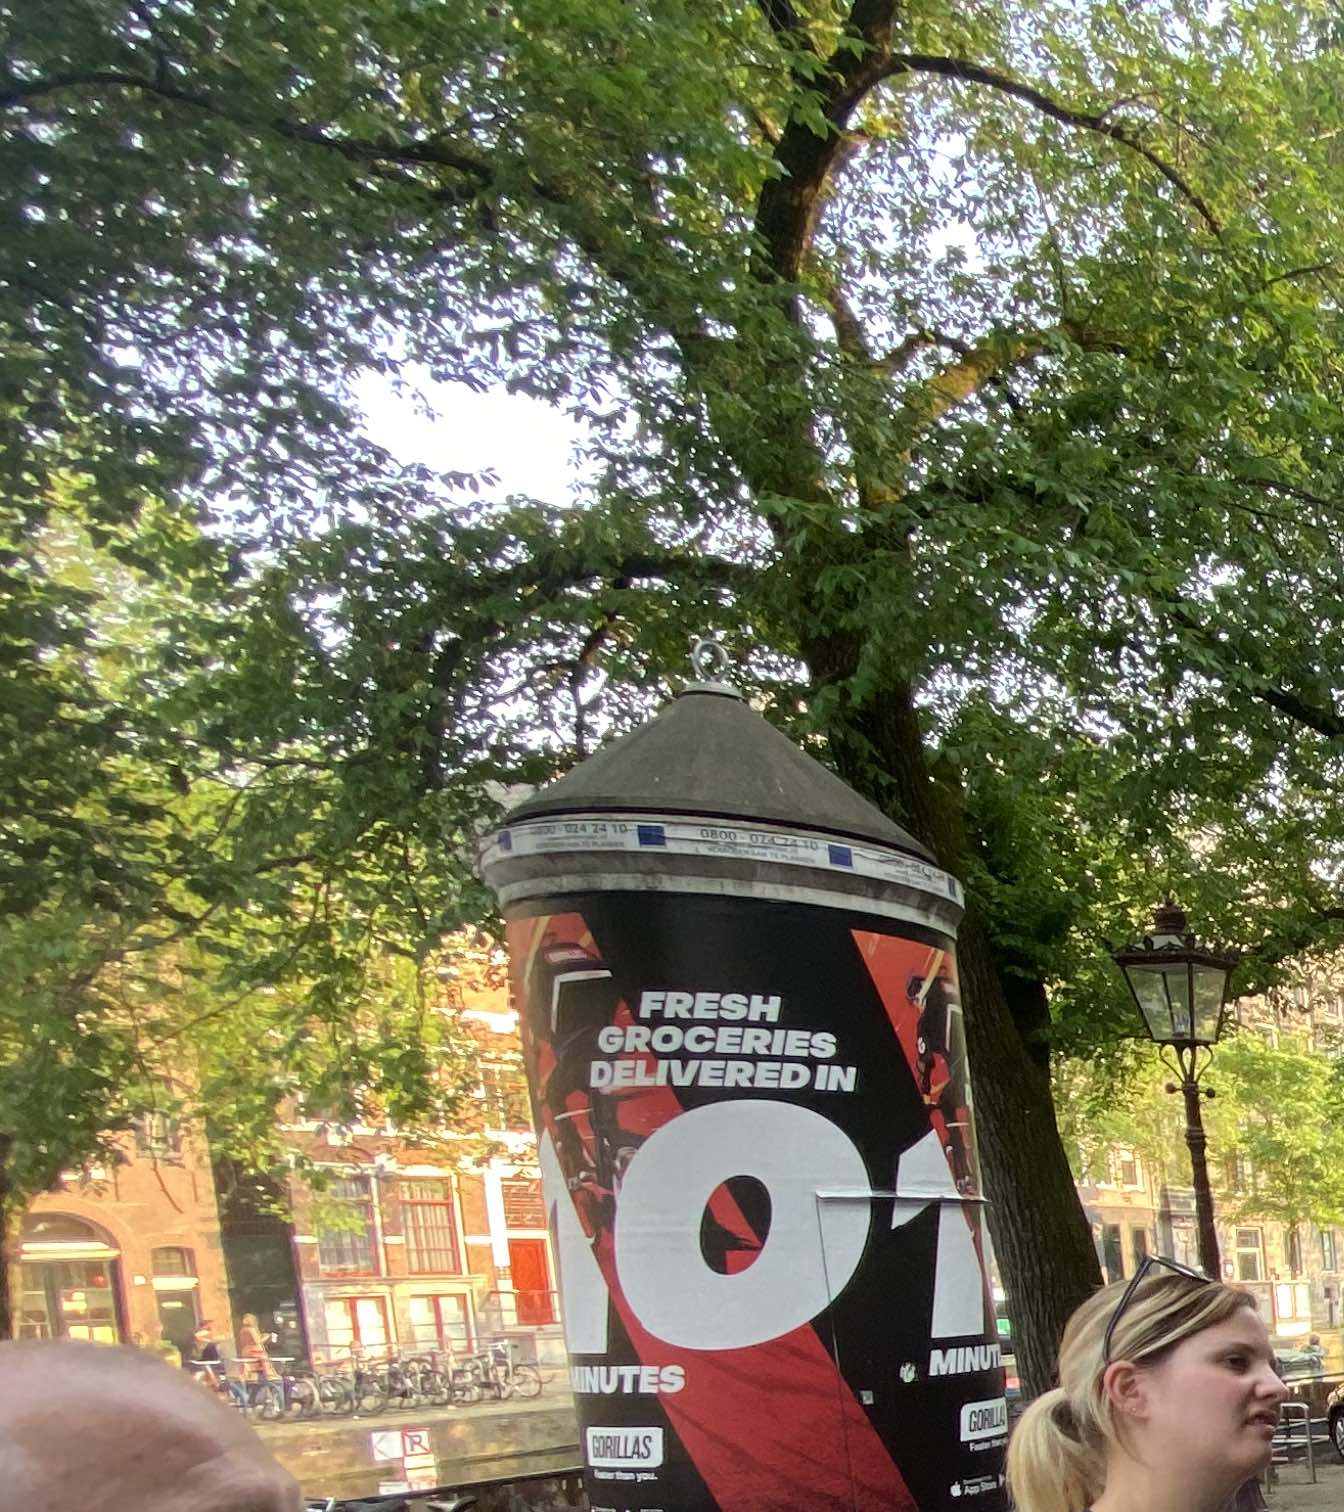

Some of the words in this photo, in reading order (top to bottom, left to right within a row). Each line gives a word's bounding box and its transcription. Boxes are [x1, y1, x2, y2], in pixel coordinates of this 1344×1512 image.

[700, 829, 737, 841] 0800
[639, 991, 782, 1022] FRESH
[598, 1025, 837, 1059] GROCERIES
[589, 1059, 811, 1089] DELIVERED
[813, 1064, 857, 1092] IN
[592, 1435, 652, 1459] GORILLAS
